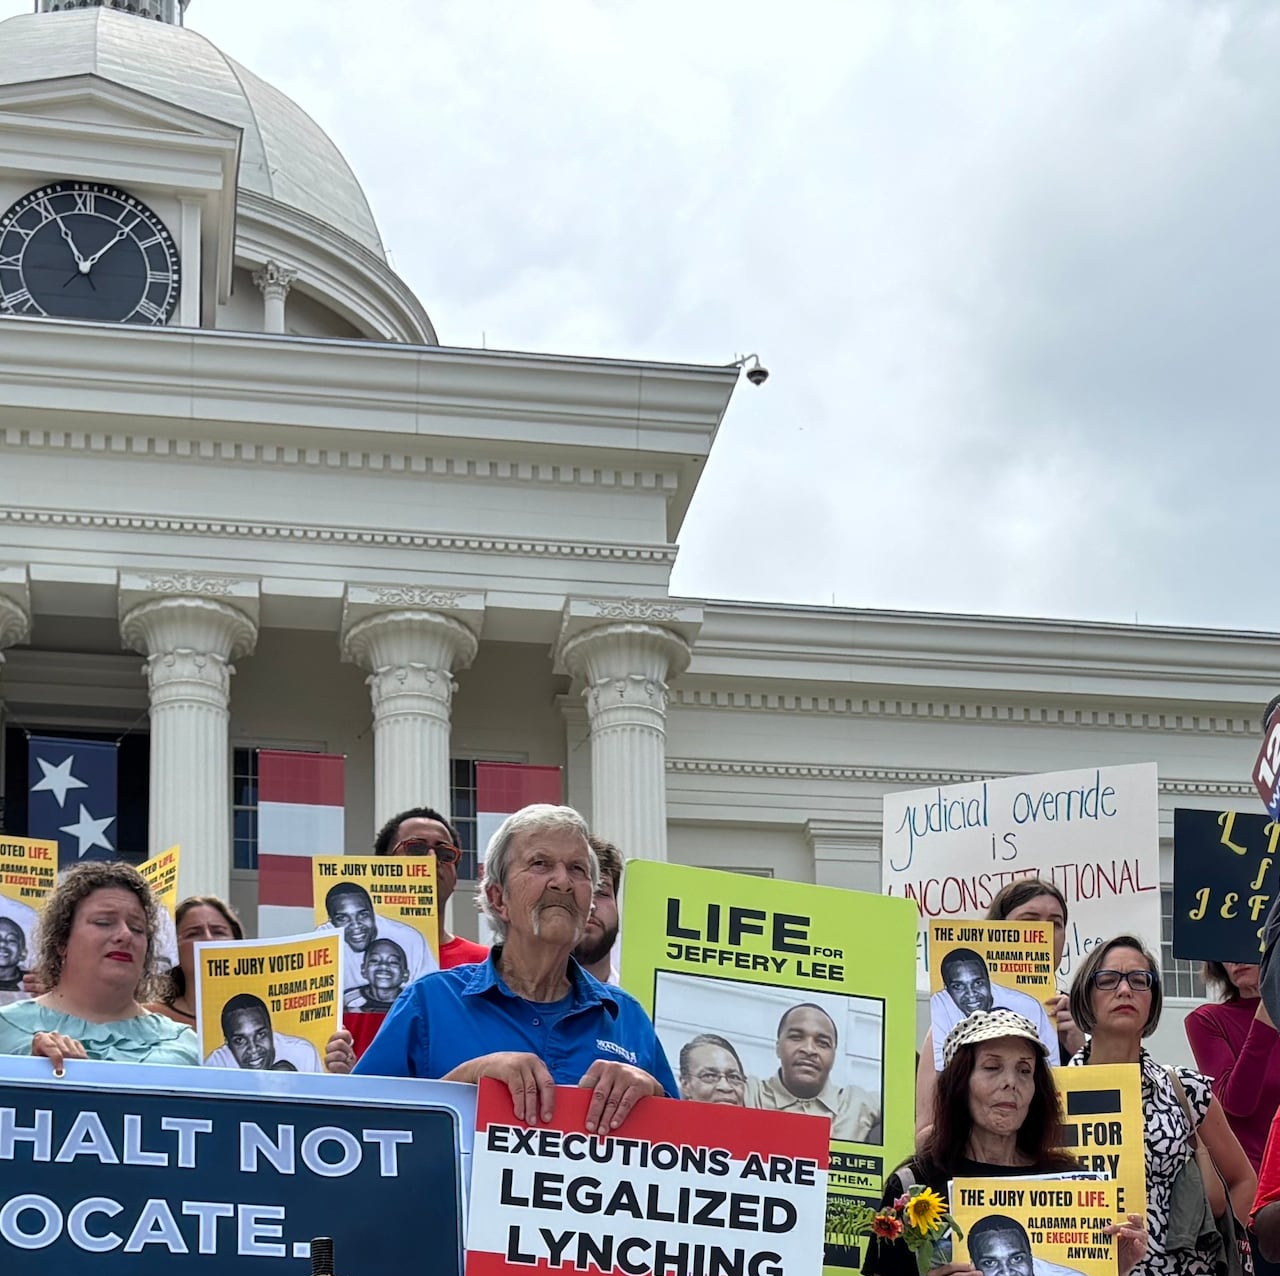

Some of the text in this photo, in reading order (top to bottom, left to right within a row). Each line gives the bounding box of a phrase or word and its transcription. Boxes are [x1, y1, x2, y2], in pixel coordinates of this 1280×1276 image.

[1013, 769, 1117, 824] override
[28, 846, 53, 861] LIFE.
[30, 866, 54, 877] PLANS
[318, 863, 431, 877] THE JURY VOTED LIFE.
[4, 875, 37, 887] EXECUTE
[38, 878, 54, 888] HIM
[370, 884, 433, 894] ALABAMA PLANS
[888, 859, 1157, 918] NCONSTIONAL
[373, 895, 433, 906] TO EXECUTE HIM
[666, 897, 844, 959] LIFE FOR
[934, 927, 1048, 944] THE JURY VOTED LIFE.
[207, 948, 333, 977] THE JURY VOTED LIFE.
[666, 942, 845, 982] JEFFERY LEE
[986, 950, 1050, 961] ALABAMA PLANS
[989, 962, 1050, 973] TO EXECUTE HIM
[268, 974, 335, 997] ALABAMA PLANS
[271, 990, 334, 1013] TO EXECUTE HIM
[1081, 1121, 1123, 1146] FOR
[239, 1120, 414, 1179] NOT
[487, 1125, 817, 1187] EXECUTIONS ARE
[846, 1157, 876, 1170] LIFE
[828, 1173, 873, 1187] THEM.
[500, 1168, 798, 1234] LEGALIZED
[960, 1189, 985, 1206] THE
[989, 1190, 1025, 1207] JURY
[1029, 1190, 1073, 1207] VOTED
[1077, 1191, 1110, 1208] LIFE.
[1027, 1217, 1113, 1230] ALABAMA PLANS
[1031, 1232, 1113, 1245] TO EXECUTE HIM
[1067, 1247, 1113, 1261] ANYWAY.
